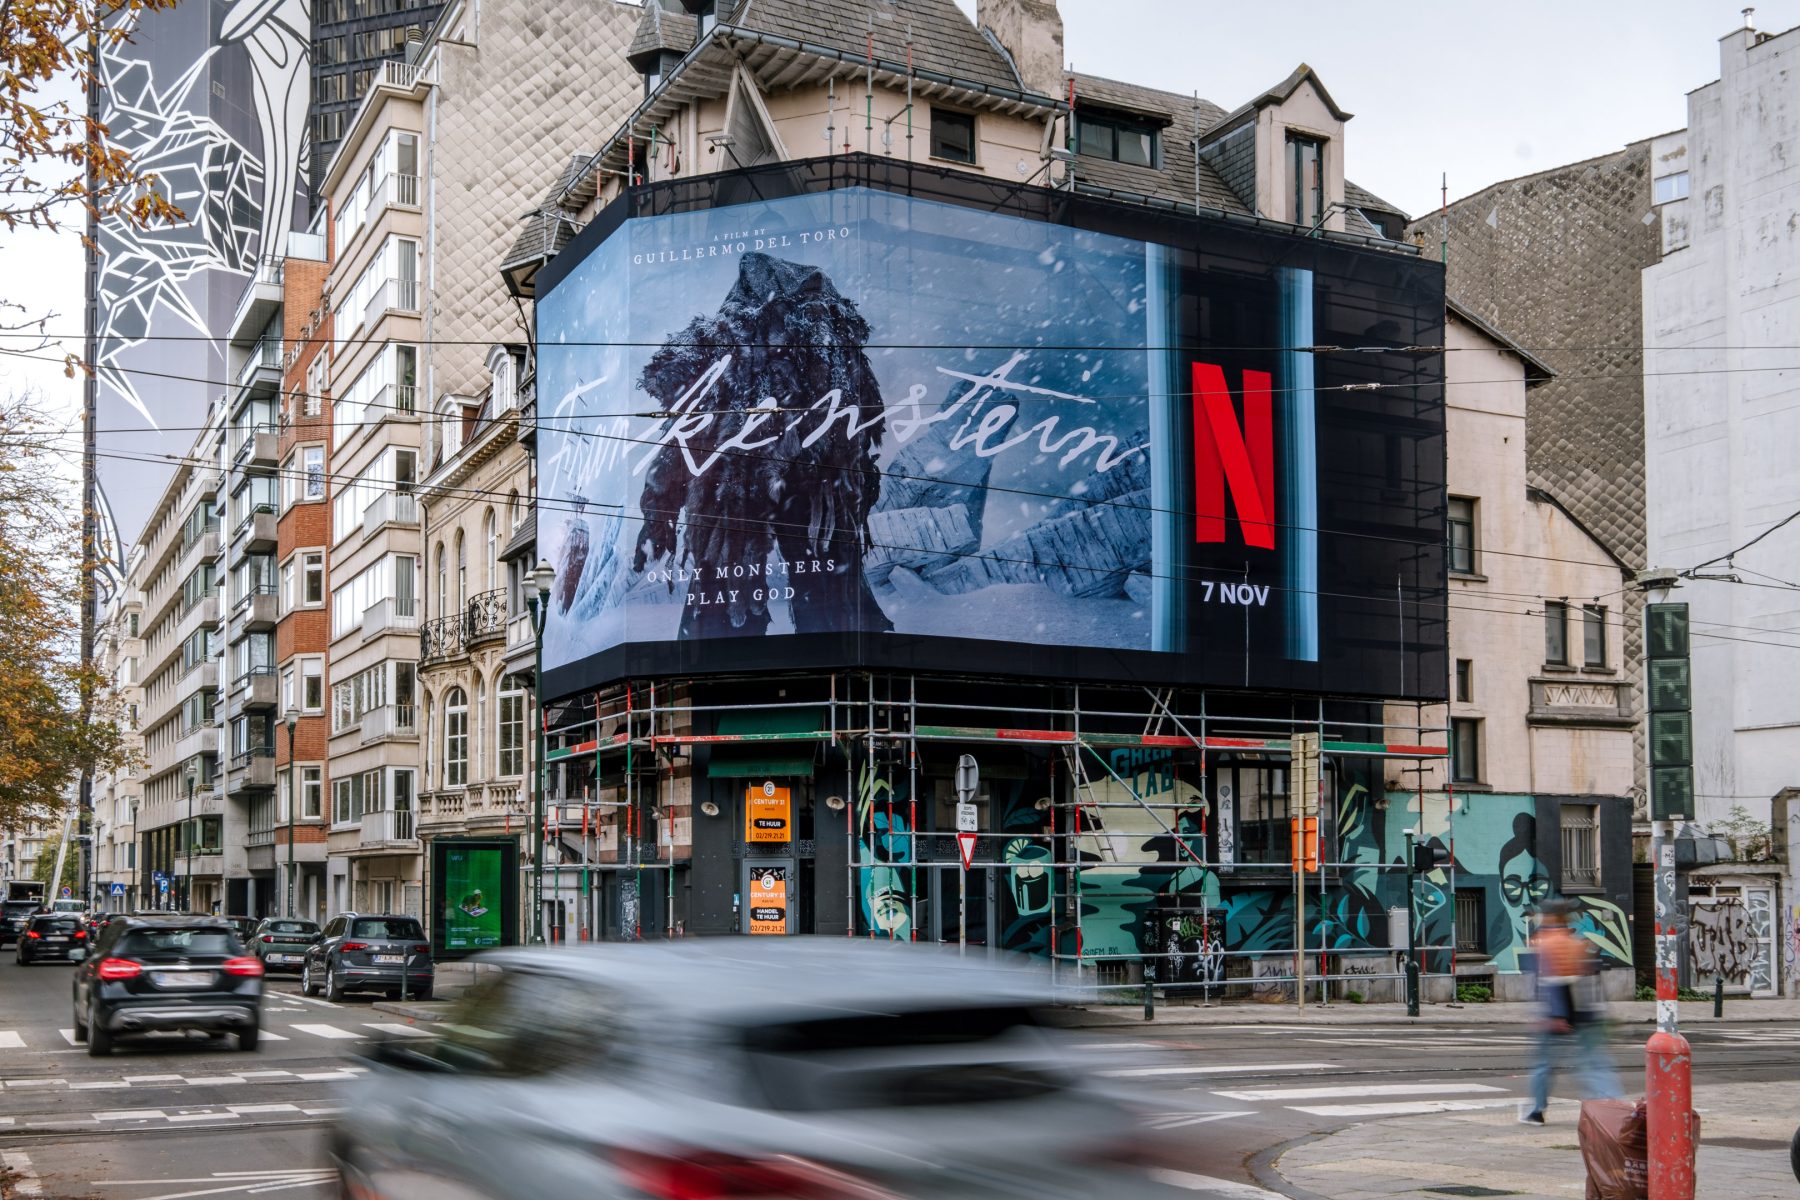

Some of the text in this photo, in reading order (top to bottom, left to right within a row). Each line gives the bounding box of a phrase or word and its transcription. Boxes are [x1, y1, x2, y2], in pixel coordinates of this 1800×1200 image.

[633, 227, 850, 265] GUILLERMO DEL TORO
[713, 228, 766, 242] A FILM BY
[540, 353, 1149, 516] Frankenstein
[1191, 361, 1275, 551] N
[647, 559, 836, 583] ONLY MONSTERS
[687, 586, 796, 606] PLAY GOD
[1201, 581, 1270, 606] 7 NOV
[1133, 763, 1174, 800] LAB
[161, 880, 168, 891] P
